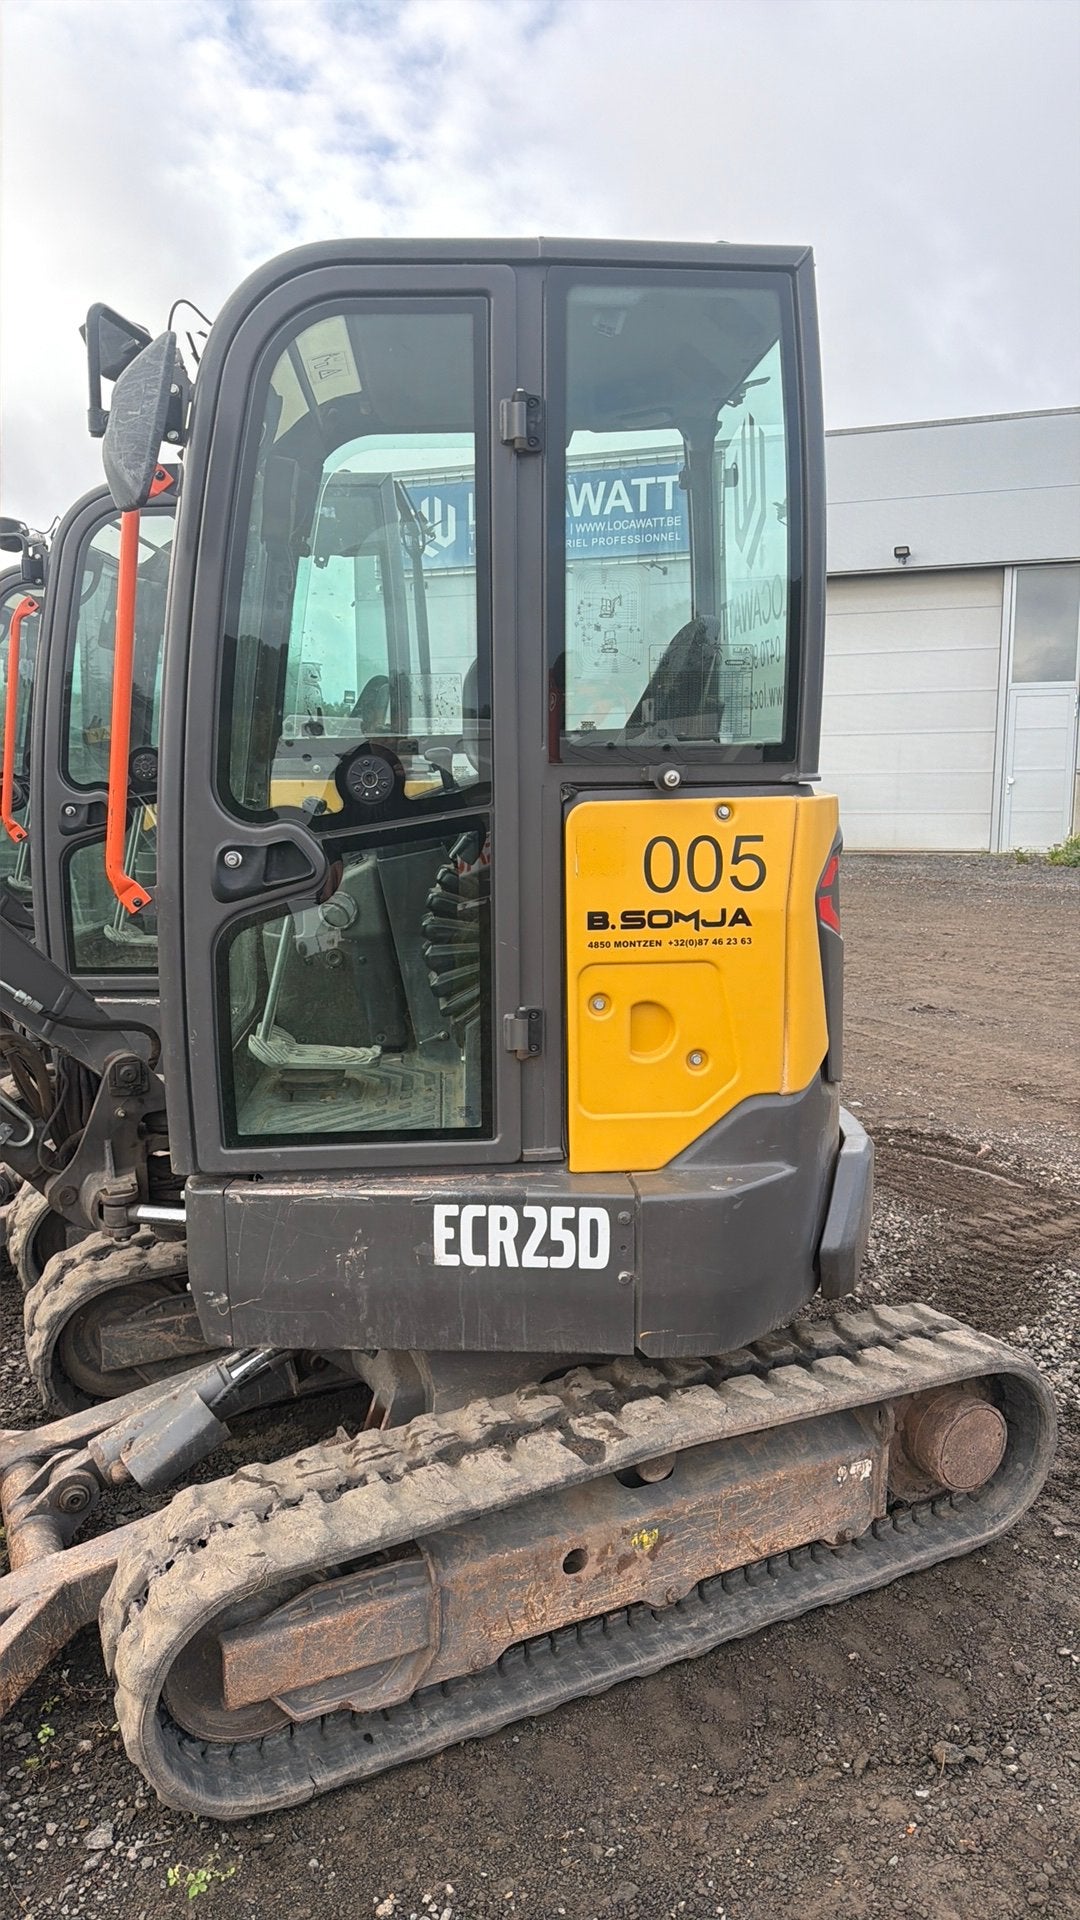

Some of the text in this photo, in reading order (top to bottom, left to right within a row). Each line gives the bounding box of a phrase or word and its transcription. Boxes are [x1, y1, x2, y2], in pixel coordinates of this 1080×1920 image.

[566, 474, 680, 517] WATT
[575, 515, 682, 533] WWW.LOCAWATT.BE
[591, 531, 681, 547] PROFESSIONNEL
[643, 834, 767, 893] 005
[587, 907, 752, 932] B.SOMJA
[588, 937, 752, 949] 4850 MONTZEN +32(0)87 46 23 63
[434, 1204, 610, 1270] ECR25D
